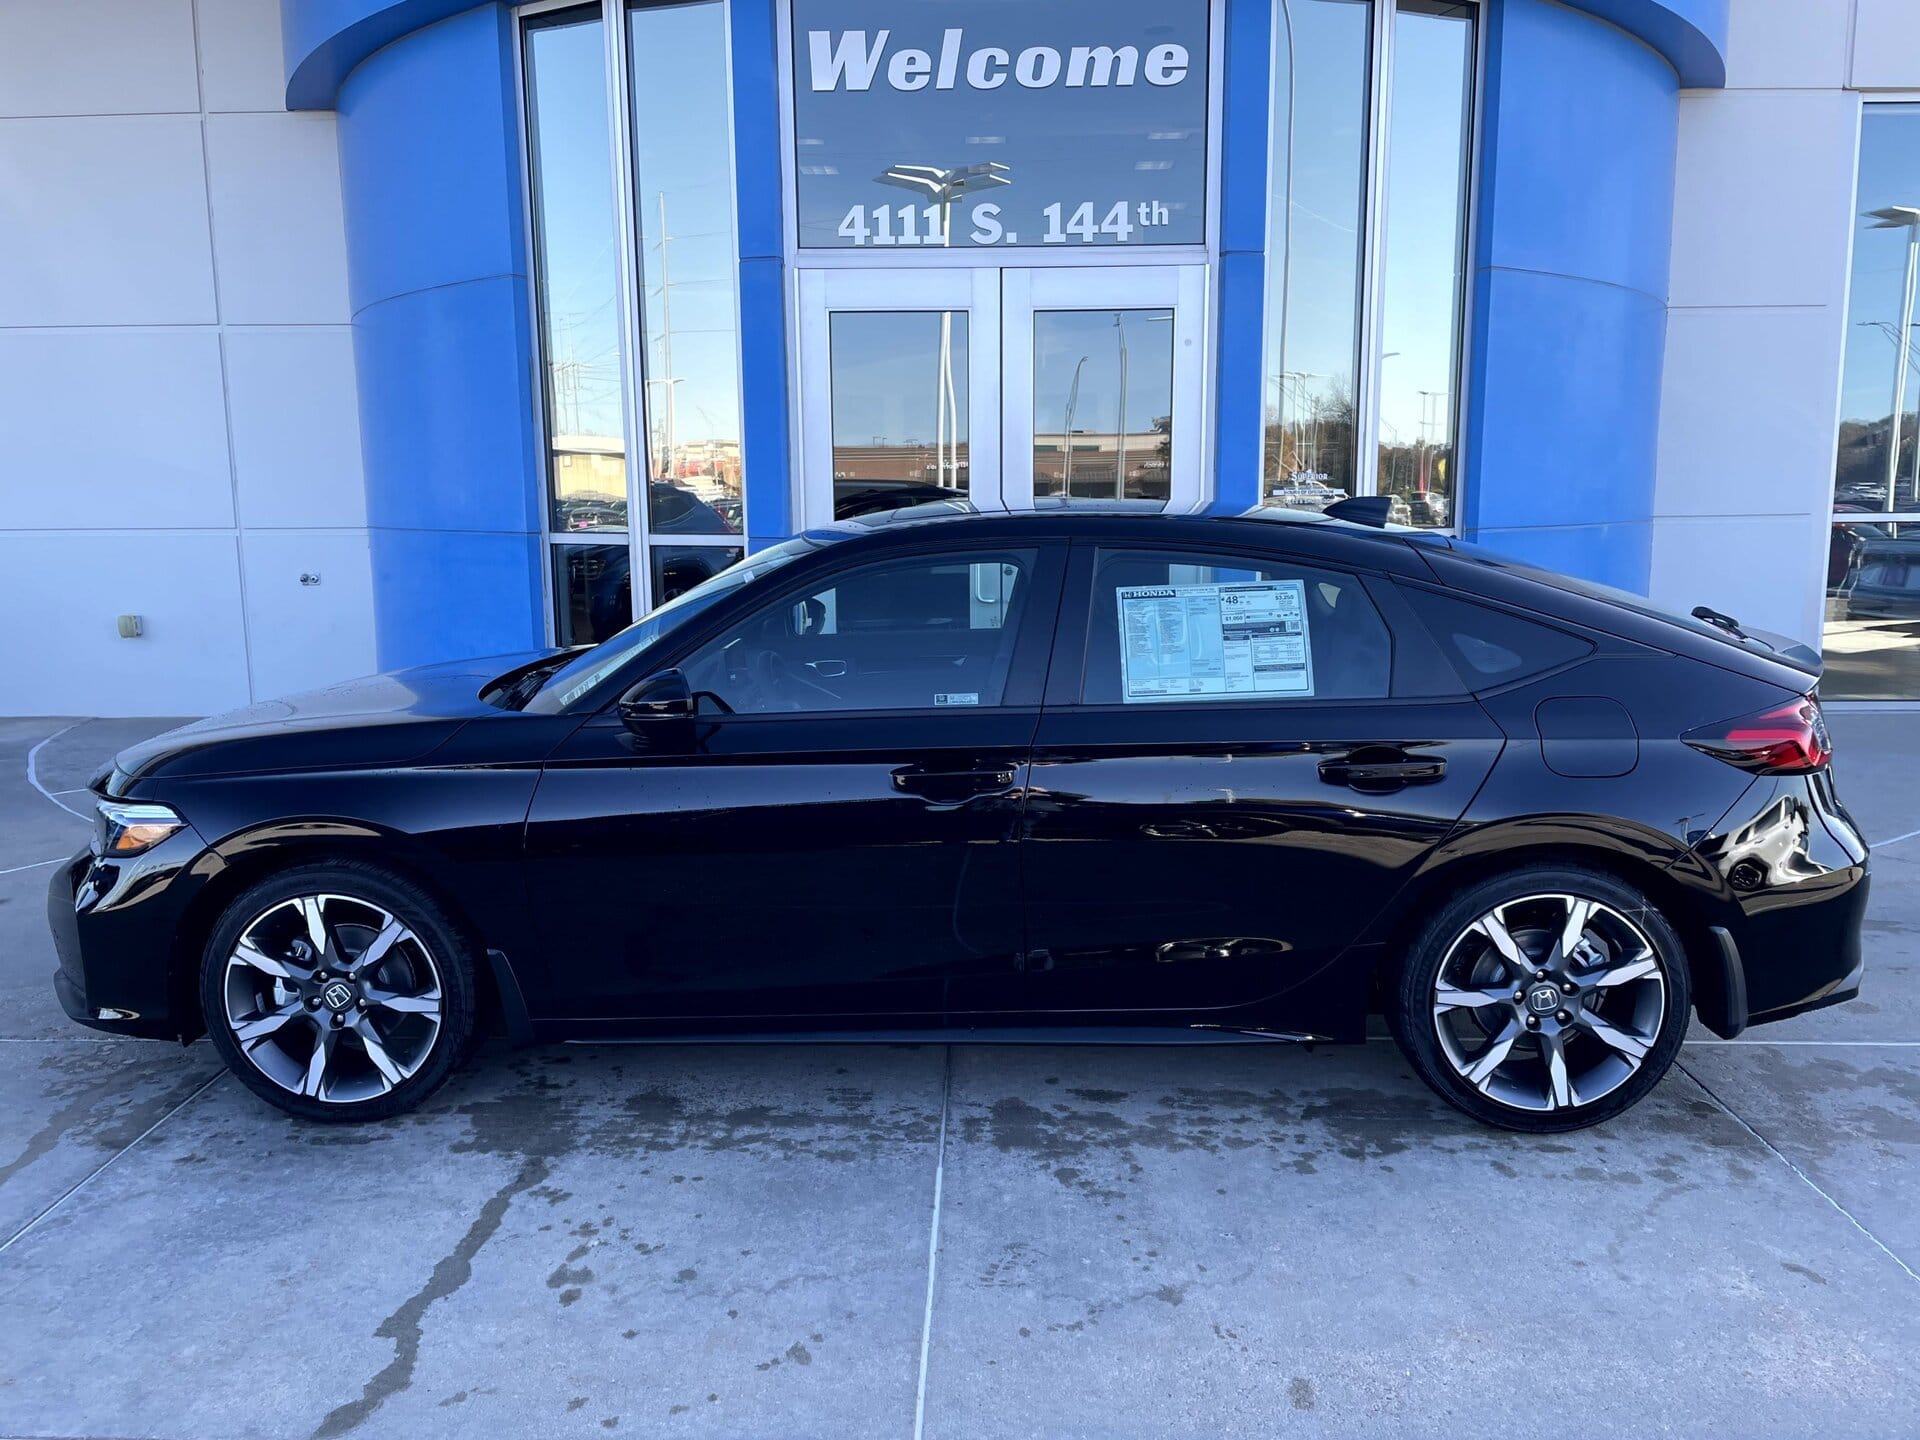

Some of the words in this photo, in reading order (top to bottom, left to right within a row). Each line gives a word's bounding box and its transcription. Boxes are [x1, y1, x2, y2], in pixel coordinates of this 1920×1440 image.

[808, 28, 1190, 91] Welcome
[838, 203, 946, 246] 4111
[969, 202, 1018, 245] S.
[1133, 589, 1175, 598] HONDA
[1225, 595, 1239, 605] 48
